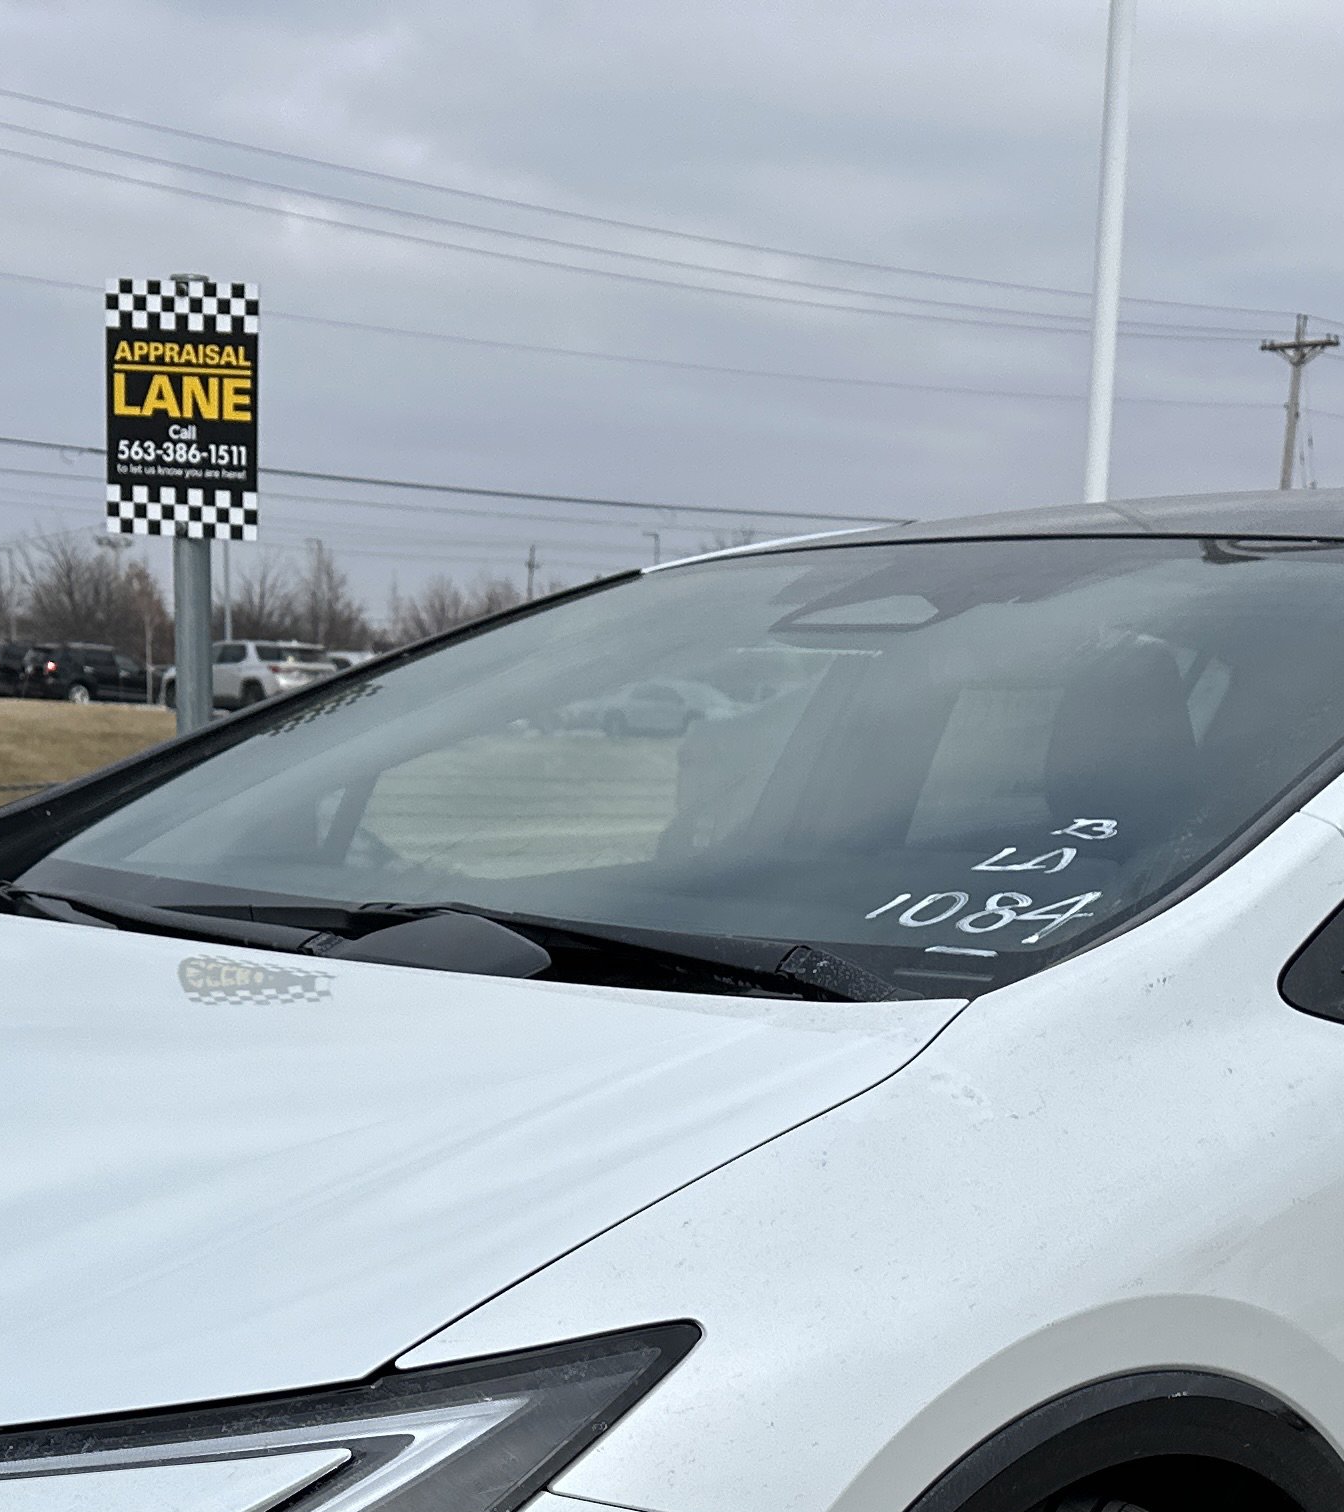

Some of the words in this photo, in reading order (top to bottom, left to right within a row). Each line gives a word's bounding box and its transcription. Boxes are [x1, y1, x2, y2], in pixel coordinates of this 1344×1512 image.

[114, 340, 251, 367] APPRAISAL
[113, 372, 252, 421] LANE
[168, 424, 197, 440] Call
[117, 439, 247, 466] 563-386-1511
[116, 463, 129, 474] to
[129, 463, 143, 475] let
[144, 466, 156, 475] us
[157, 465, 184, 477] know
[184, 468, 203, 480] you
[864, 890, 1103, 944] 1084
